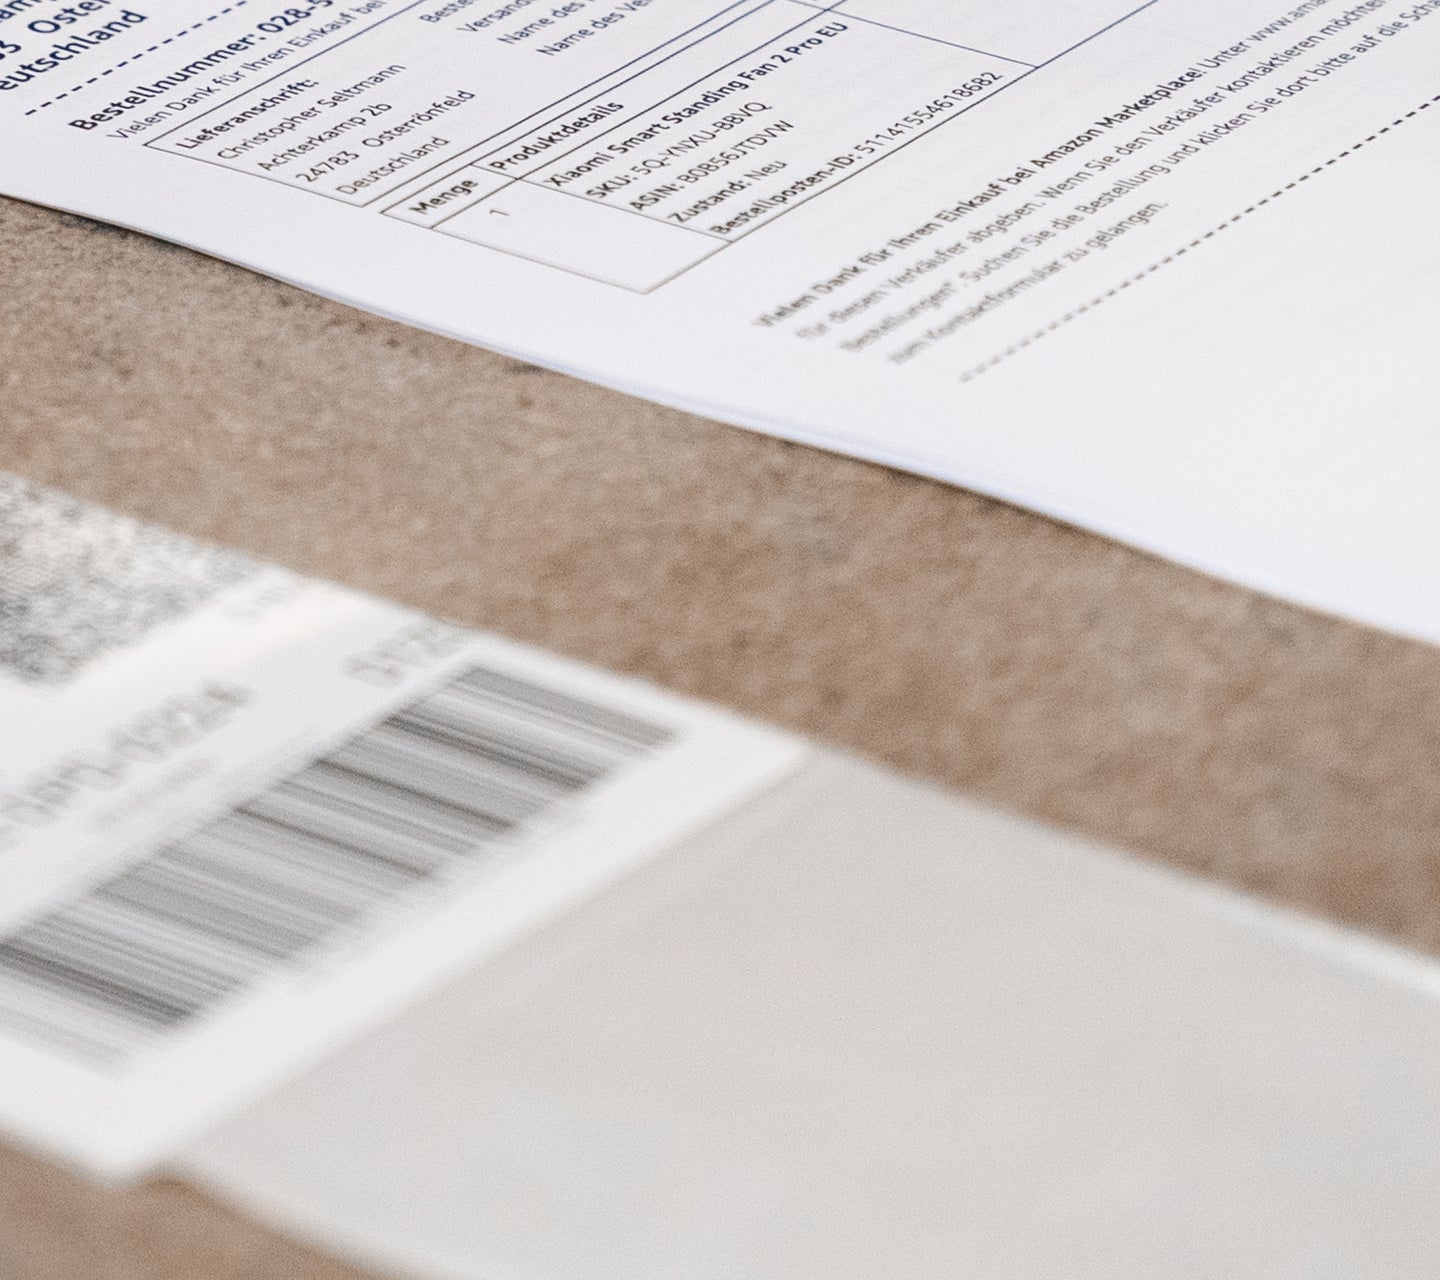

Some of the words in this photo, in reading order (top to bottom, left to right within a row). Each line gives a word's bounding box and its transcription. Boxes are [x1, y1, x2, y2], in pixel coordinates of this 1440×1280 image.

[496, 17, 555, 44] Name
[550, 1, 586, 18] des
[535, 28, 595, 56] Name
[589, 11, 625, 29] des
[68, 33, 265, 130] Bestellnummer:
[105, 110, 172, 138] Vielen
[164, 85, 220, 111] Dank
[210, 70, 245, 86] für
[239, 47, 294, 71] Ihren
[285, 11, 356, 48] Einkauf
[544, 151, 614, 187] Xiaomi
[606, 123, 670, 154] Smart
[660, 80, 749, 124] Standing
[736, 62, 778, 81] Fan
[769, 53, 793, 63] 2
[783, 37, 823, 55] Pro
[814, 21, 848, 37] EU
[175, 79, 318, 149] Lieferanschrift:
[216, 106, 321, 159] Christopher
[315, 64, 406, 108] Seltmann
[257, 116, 366, 171] Achterkamp
[358, 103, 393, 117] 2b
[294, 149, 360, 182] 24783
[361, 89, 475, 147] Osterrönfeld
[488, 102, 624, 170] Produktdetails
[966, 202, 1041, 243] abgeben.
[1035, 170, 1093, 199] Wenn
[1083, 155, 1120, 171] Sie
[1113, 136, 1152, 155] den
[1141, 91, 1225, 135] Verkäufer
[1216, 34, 1325, 92] kontaktieren
[335, 136, 450, 195] Deutschland
[709, 153, 862, 234] Bestellposten-ID:
[853, 71, 1003, 153] 51141554618682
[810, 265, 865, 294] Dank
[856, 247, 893, 265] für
[886, 221, 943, 249] Ihren
[934, 182, 1006, 222] Einkauf
[997, 166, 1036, 185] bei
[1029, 128, 1103, 168] Amazon
[1094, 67, 1202, 128] Marketplace!
[1196, 40, 1250, 68] Unter
[958, 245, 1029, 281] Suchen
[1019, 229, 1057, 246] Sie
[1050, 213, 1084, 230] die
[1074, 164, 1171, 214] Bestellung
[1161, 142, 1201, 164] und
[1188, 112, 1255, 145] klicken
[1245, 96, 1282, 113] Sie
[1275, 75, 1318, 97] dort
[1305, 52, 1356, 76] bitte
[1349, 34, 1381, 53] auf
[1376, 20, 1409, 37] die
[408, 179, 478, 214] Menge
[488, 208, 509, 216] 1
[584, 174, 638, 198] SKU:
[628, 183, 684, 211] ASIN:
[667, 179, 751, 223] Zustand:
[742, 160, 788, 180] Neu
[1084, 203, 1163, 249] gelangen.
